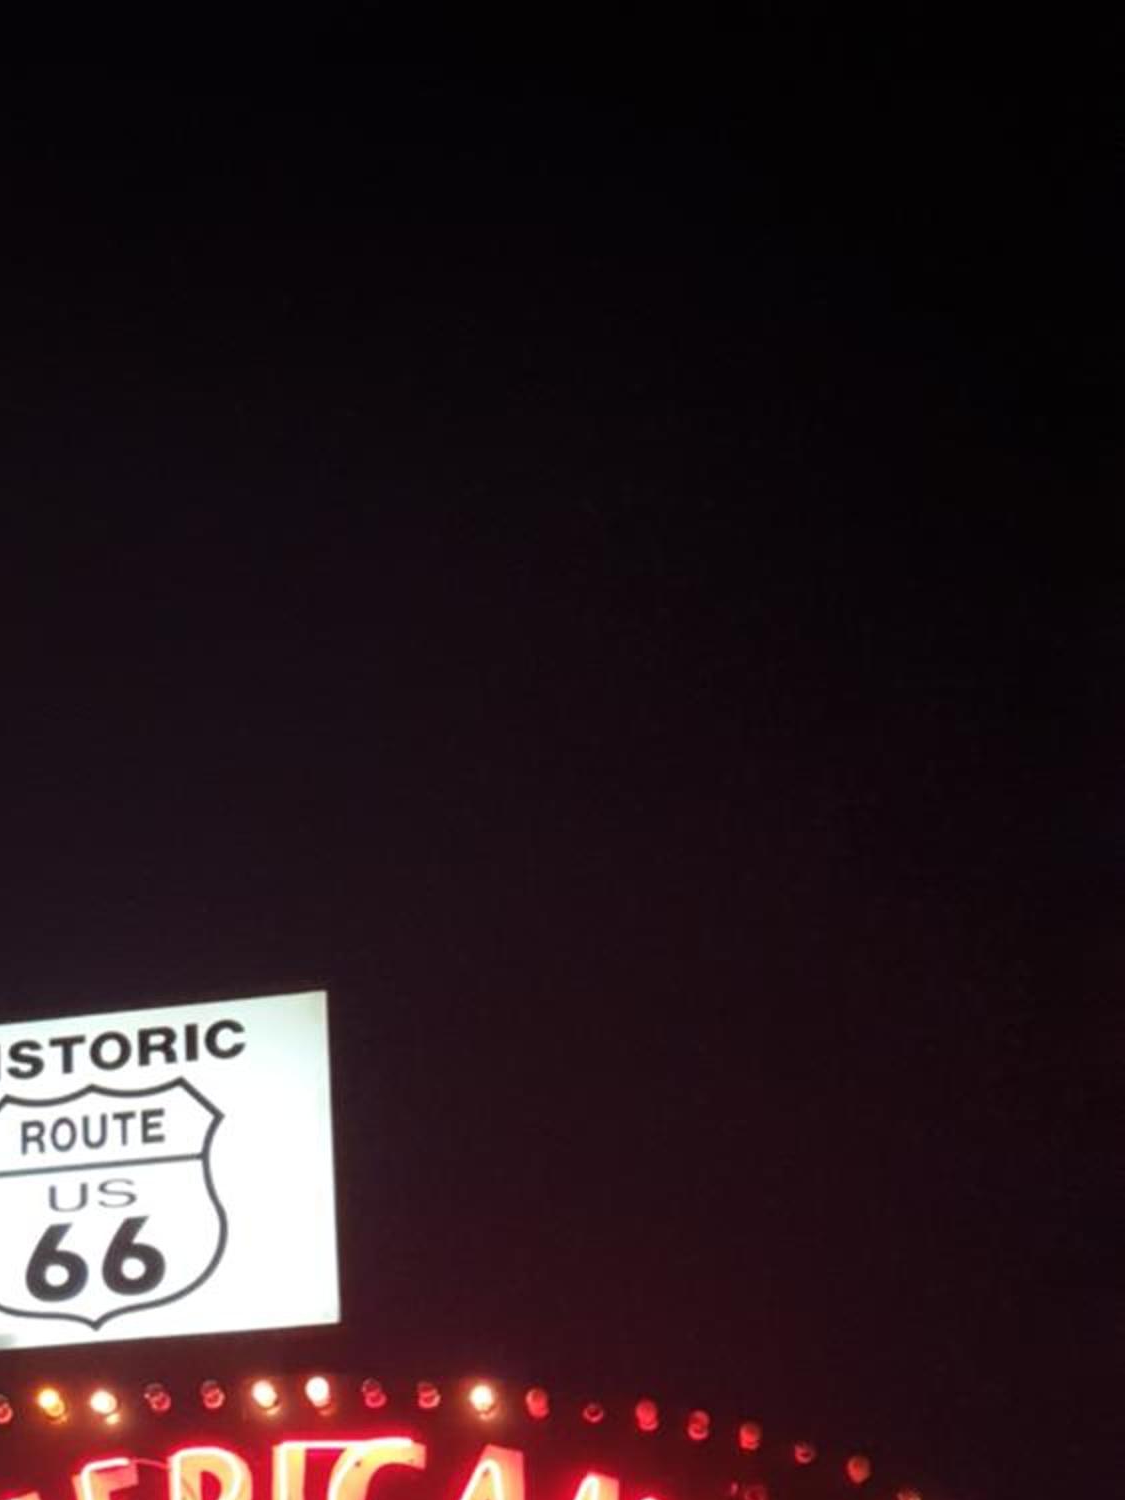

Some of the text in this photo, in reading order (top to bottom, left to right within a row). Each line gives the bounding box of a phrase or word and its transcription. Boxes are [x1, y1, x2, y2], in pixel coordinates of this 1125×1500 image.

[21, 1108, 165, 1155] ROUTE
[49, 1178, 138, 1213] US
[25, 1215, 166, 1302] 66
